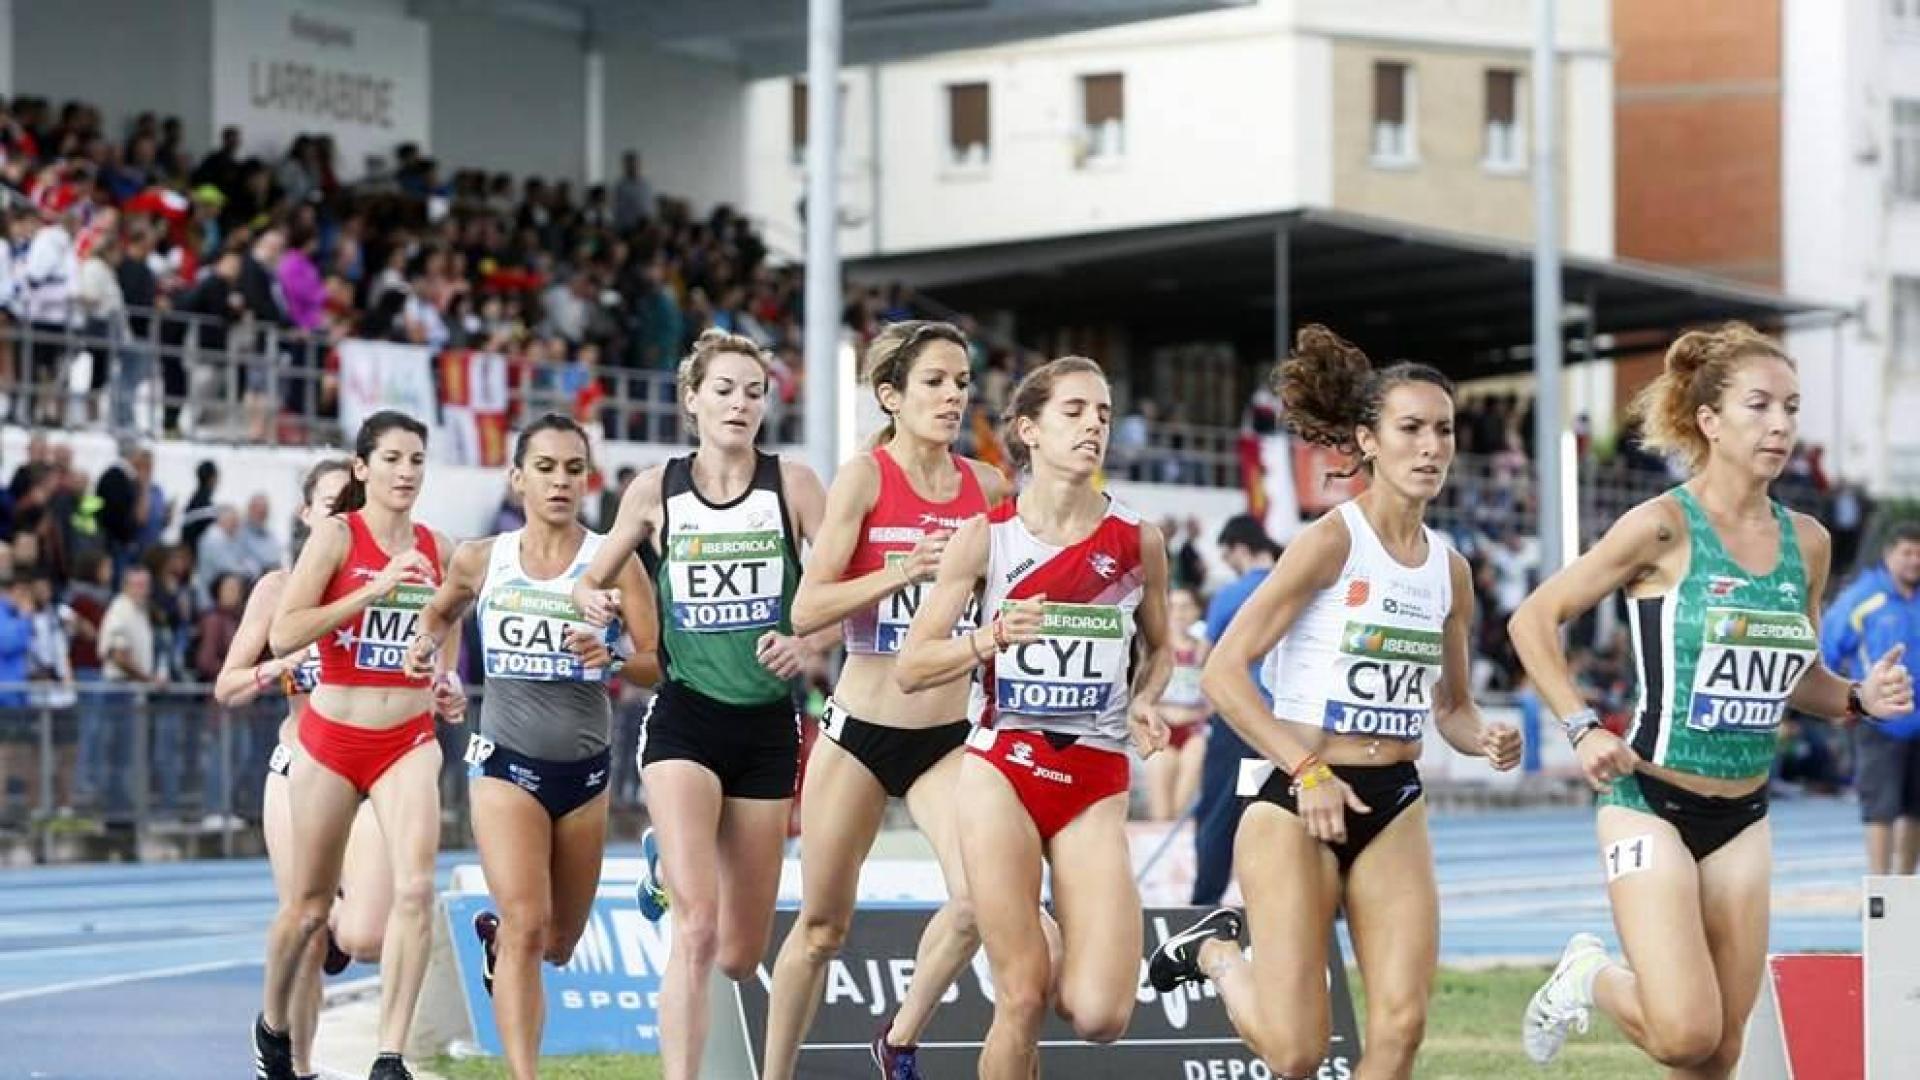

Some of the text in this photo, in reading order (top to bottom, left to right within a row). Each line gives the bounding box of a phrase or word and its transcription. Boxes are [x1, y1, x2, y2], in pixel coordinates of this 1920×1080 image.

[702, 538, 777, 554] IBERDROLA
[687, 561, 767, 598] EXT
[365, 610, 419, 642] MA
[682, 600, 770, 628] Joma
[1044, 614, 1119, 631] BERDROLA
[1016, 640, 1102, 678] CYL
[1706, 649, 1805, 693] AND
[1008, 683, 1099, 708] Joma
[1347, 660, 1426, 703] CVA
[1334, 706, 1423, 736] Joma
[1609, 839, 1645, 875] 11
